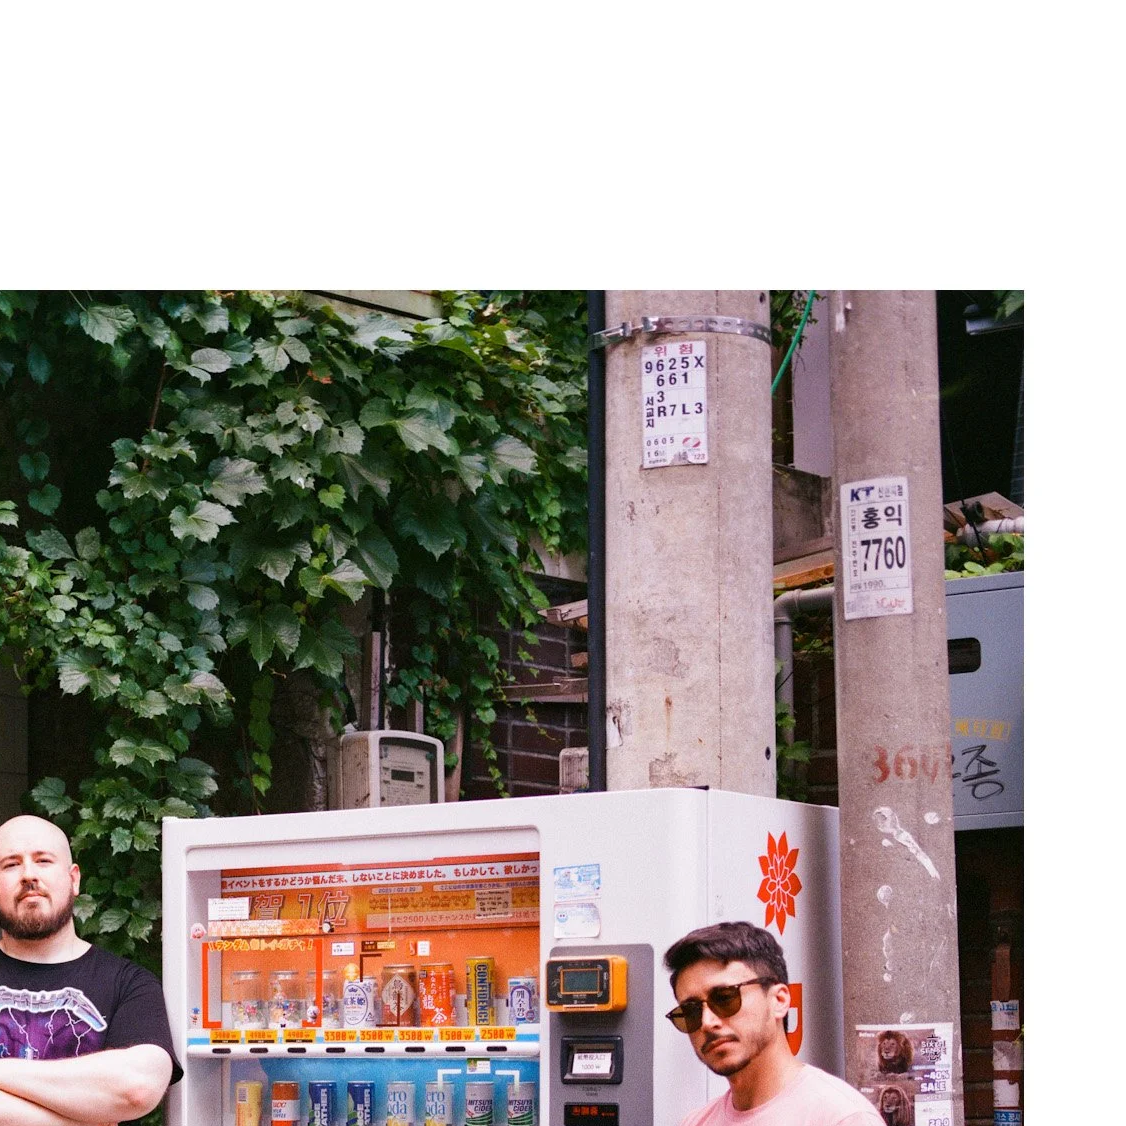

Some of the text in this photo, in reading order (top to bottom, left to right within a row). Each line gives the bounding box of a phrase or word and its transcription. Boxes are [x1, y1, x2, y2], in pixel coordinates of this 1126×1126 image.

[656, 372, 689, 387] 661
[657, 391, 665, 403] 3
[850, 486, 875, 502] KT
[860, 536, 906, 572] 7760
[476, 964, 489, 1024] CONFIDENCE
[920, 1081, 946, 1093] SALE
